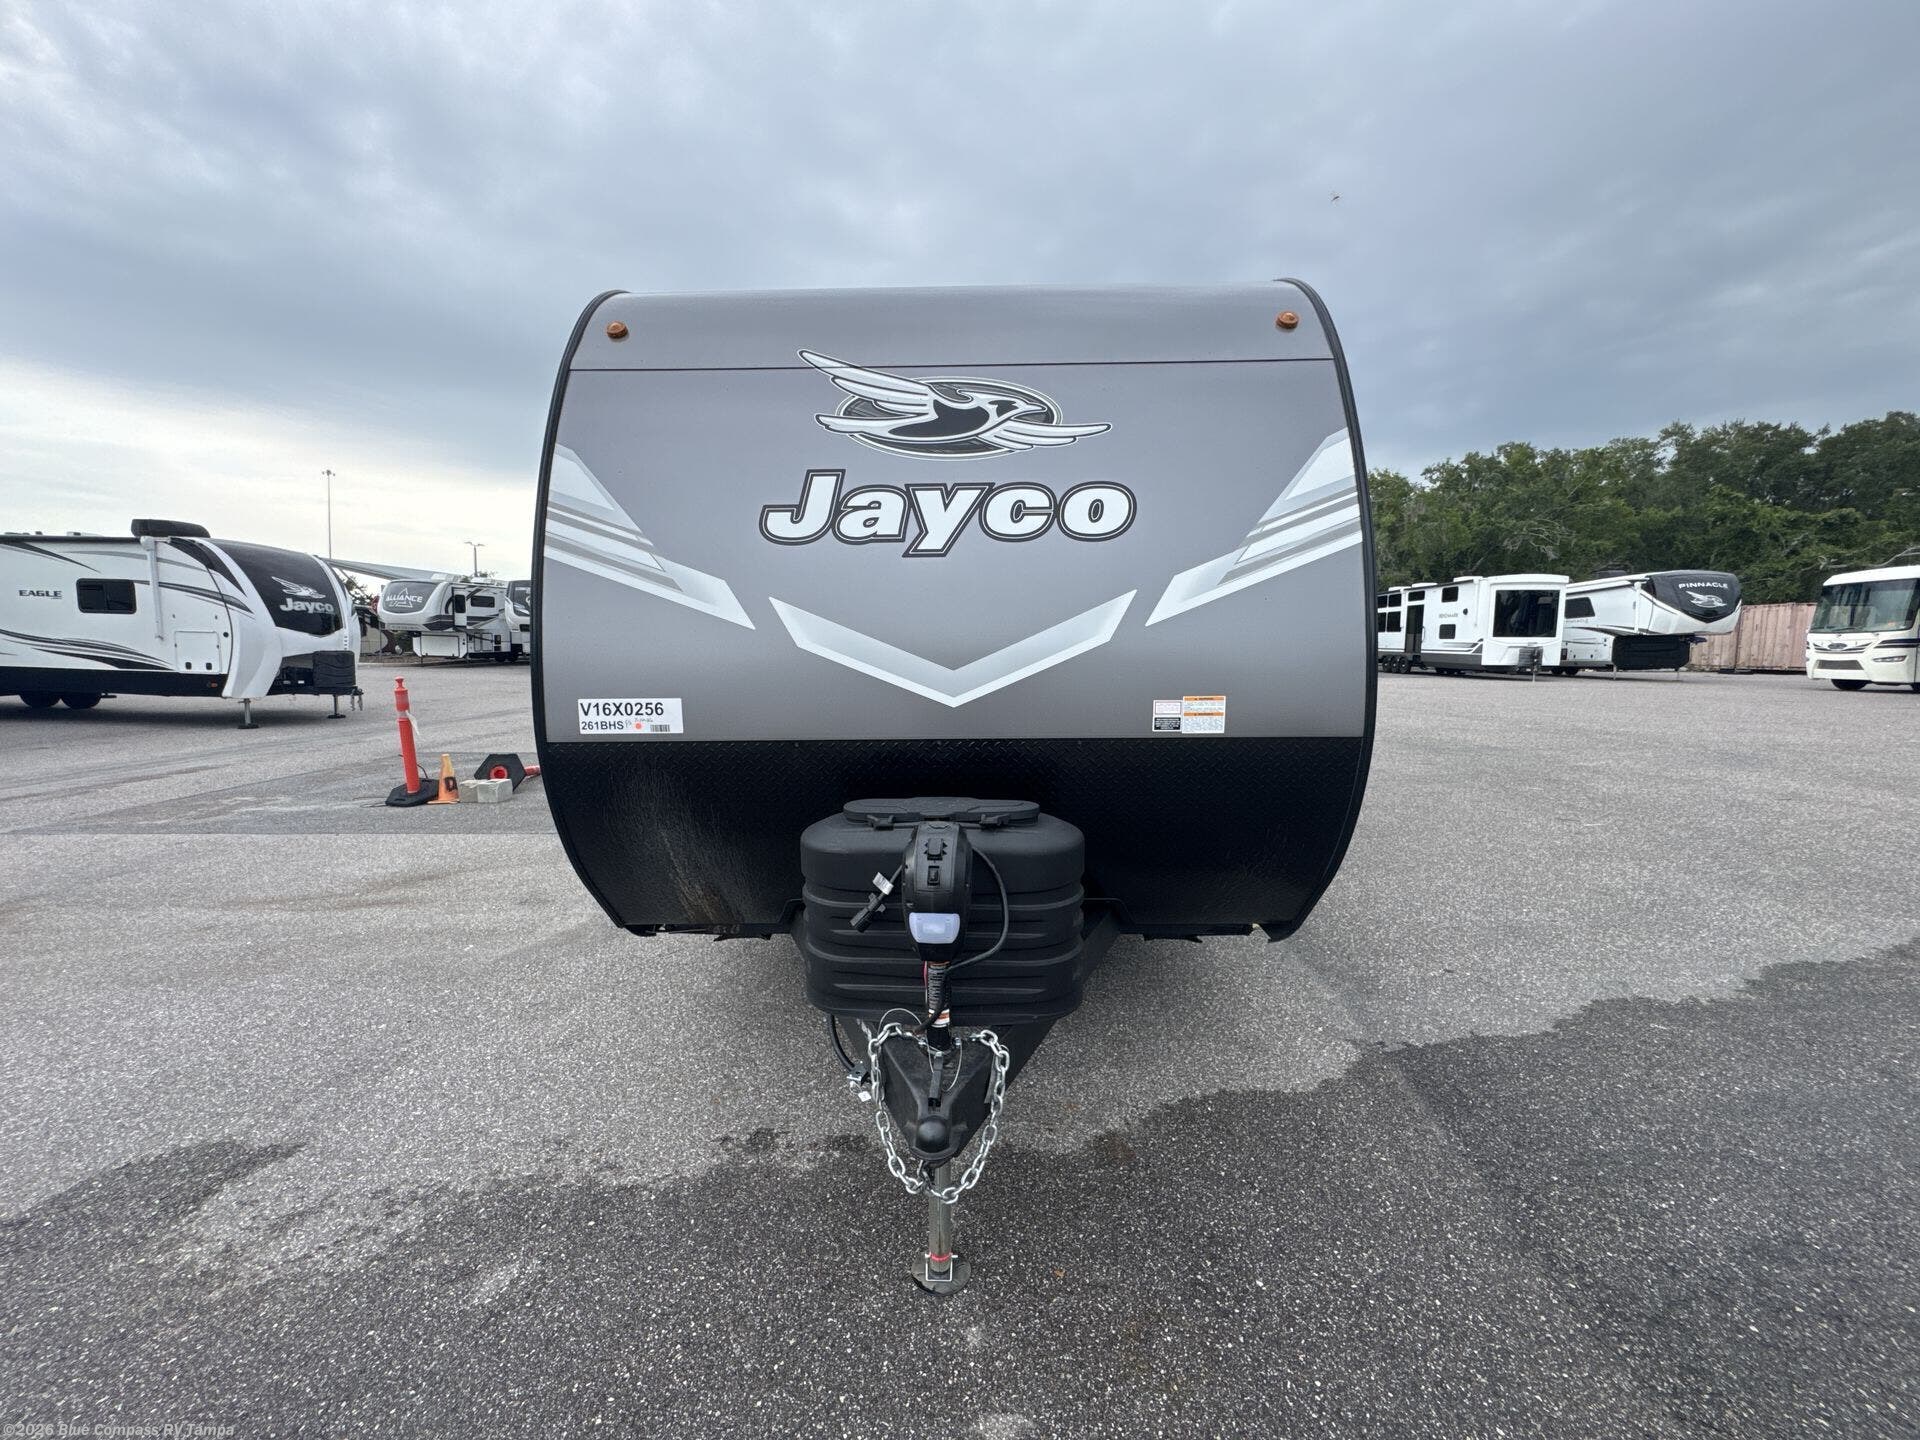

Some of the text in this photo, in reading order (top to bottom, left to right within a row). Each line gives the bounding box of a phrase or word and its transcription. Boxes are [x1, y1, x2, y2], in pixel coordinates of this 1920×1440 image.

[759, 469, 1137, 557] Jayco
[19, 590, 62, 598] EAGLE
[280, 598, 335, 614] Jayco
[580, 702, 664, 716] V16X0256
[581, 720, 624, 730] 261BHS
